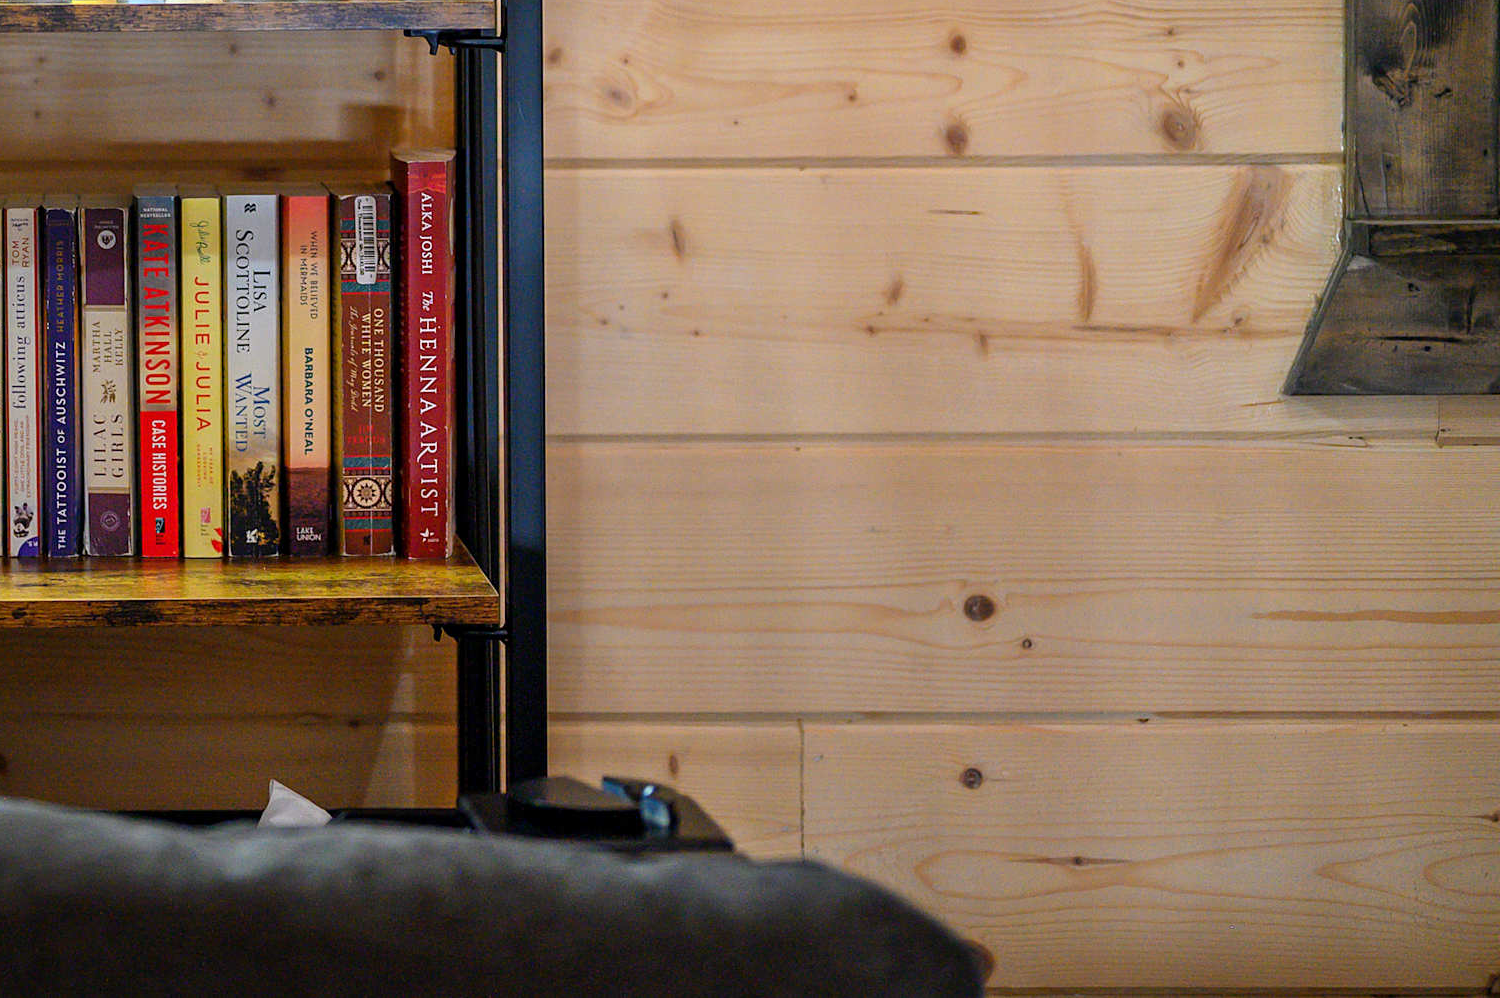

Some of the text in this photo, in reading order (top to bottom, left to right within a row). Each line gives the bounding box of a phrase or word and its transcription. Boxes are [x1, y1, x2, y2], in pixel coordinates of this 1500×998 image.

[420, 192, 433, 274] ALKA JOSHI
[15, 276, 29, 330] atticus
[142, 224, 172, 404] KATE ATKINSON
[194, 276, 210, 346] JULIE
[235, 230, 253, 352] SCOTTOLINE
[252, 270, 270, 312] LISA
[421, 291, 434, 312] The
[13, 336, 30, 409] following
[92, 321, 101, 373] MARTHA
[103, 330, 112, 364] HALL
[114, 329, 123, 366] KELLY
[360, 313, 372, 408] WHITE WOMEN
[373, 308, 384, 413] ONE THOUSAND
[419, 317, 439, 415] HENNA
[196, 361, 211, 431] JULIA
[234, 373, 253, 452] WANTED
[252, 386, 271, 439] MOST
[304, 347, 314, 455] BARBARA O'NEAL
[54, 341, 67, 550] THE TATTOOIST OF AUSCHWITZ
[94, 415, 107, 477] LILAC
[113, 413, 125, 478] GIRLS
[151, 419, 168, 510] CASE HISTORIES
[416, 422, 439, 516] ARTIST
